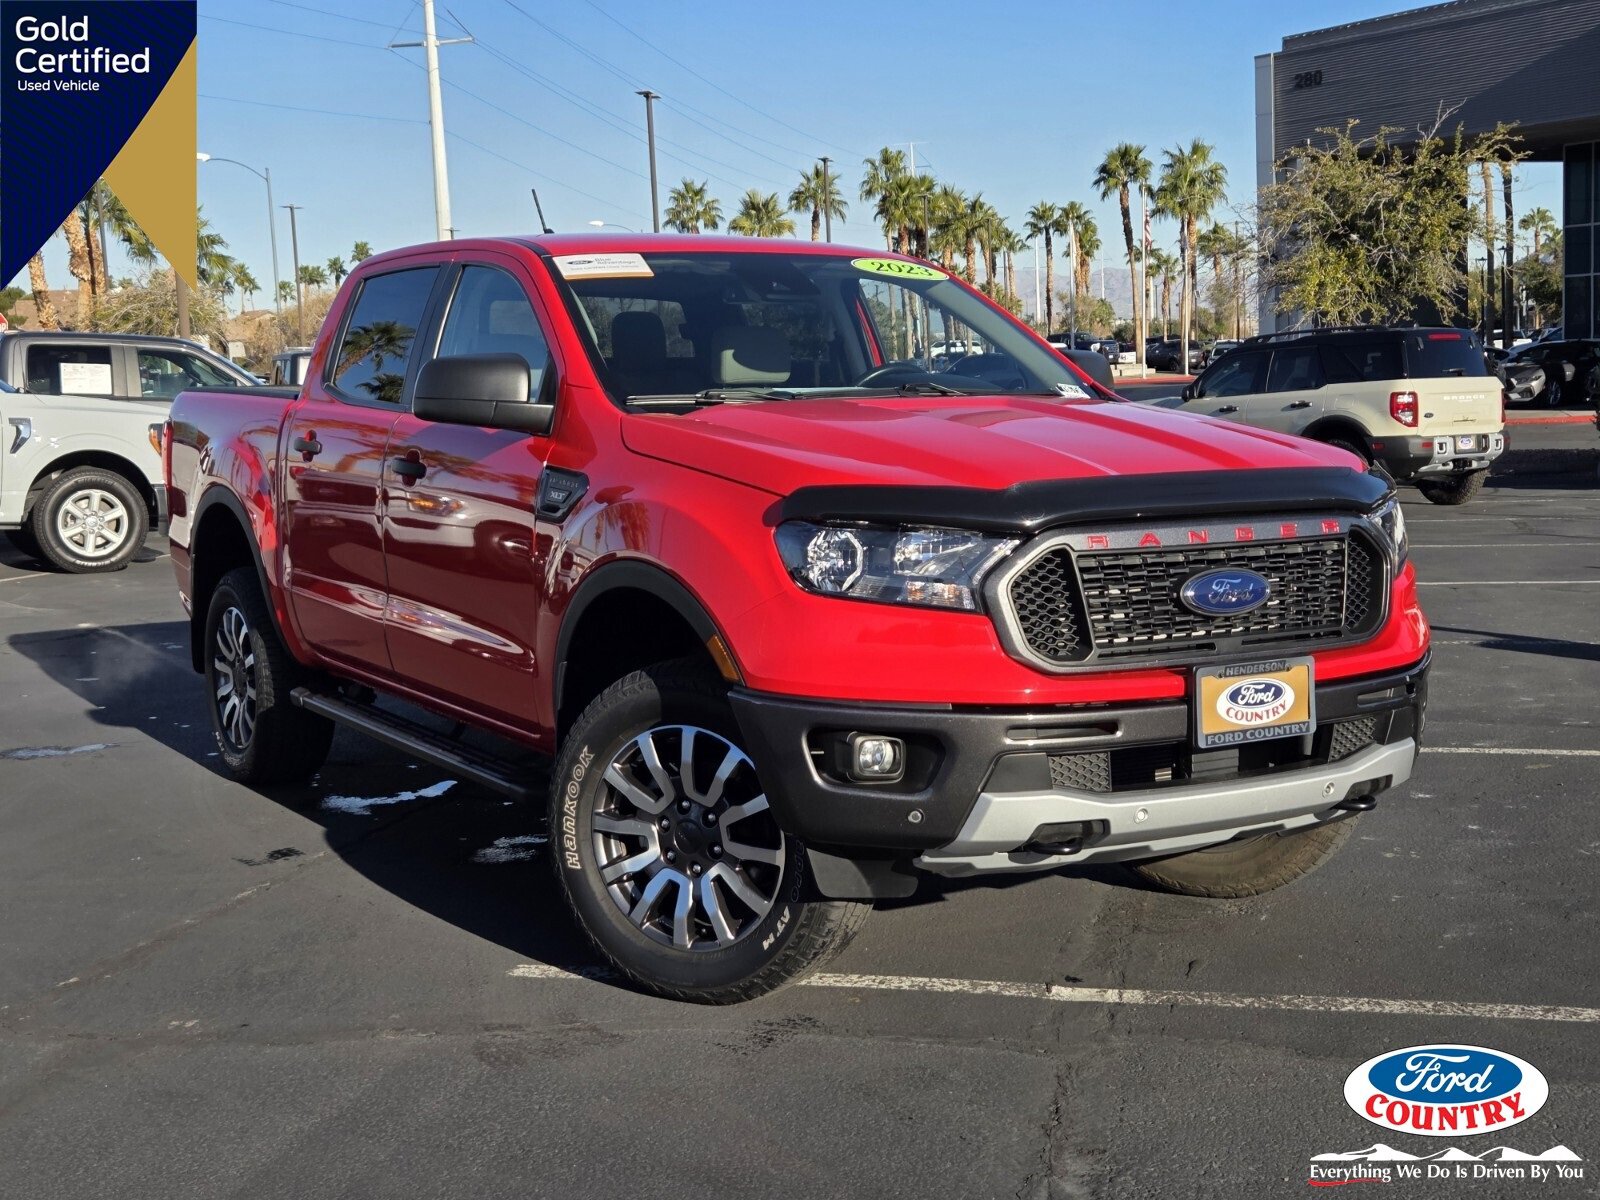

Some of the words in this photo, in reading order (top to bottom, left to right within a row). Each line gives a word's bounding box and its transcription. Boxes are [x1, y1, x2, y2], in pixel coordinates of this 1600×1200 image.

[870, 261, 933, 277] 2023
[550, 491, 565, 500] XLT
[1087, 519, 1340, 548] RANGER
[1208, 578, 1254, 602] Ford
[1225, 661, 1285, 676] HENDERSON
[1237, 684, 1275, 705] Ford
[1226, 700, 1287, 722] COUNTRY
[1207, 730, 1244, 745] FORD
[1246, 722, 1309, 740] COUNTRY
